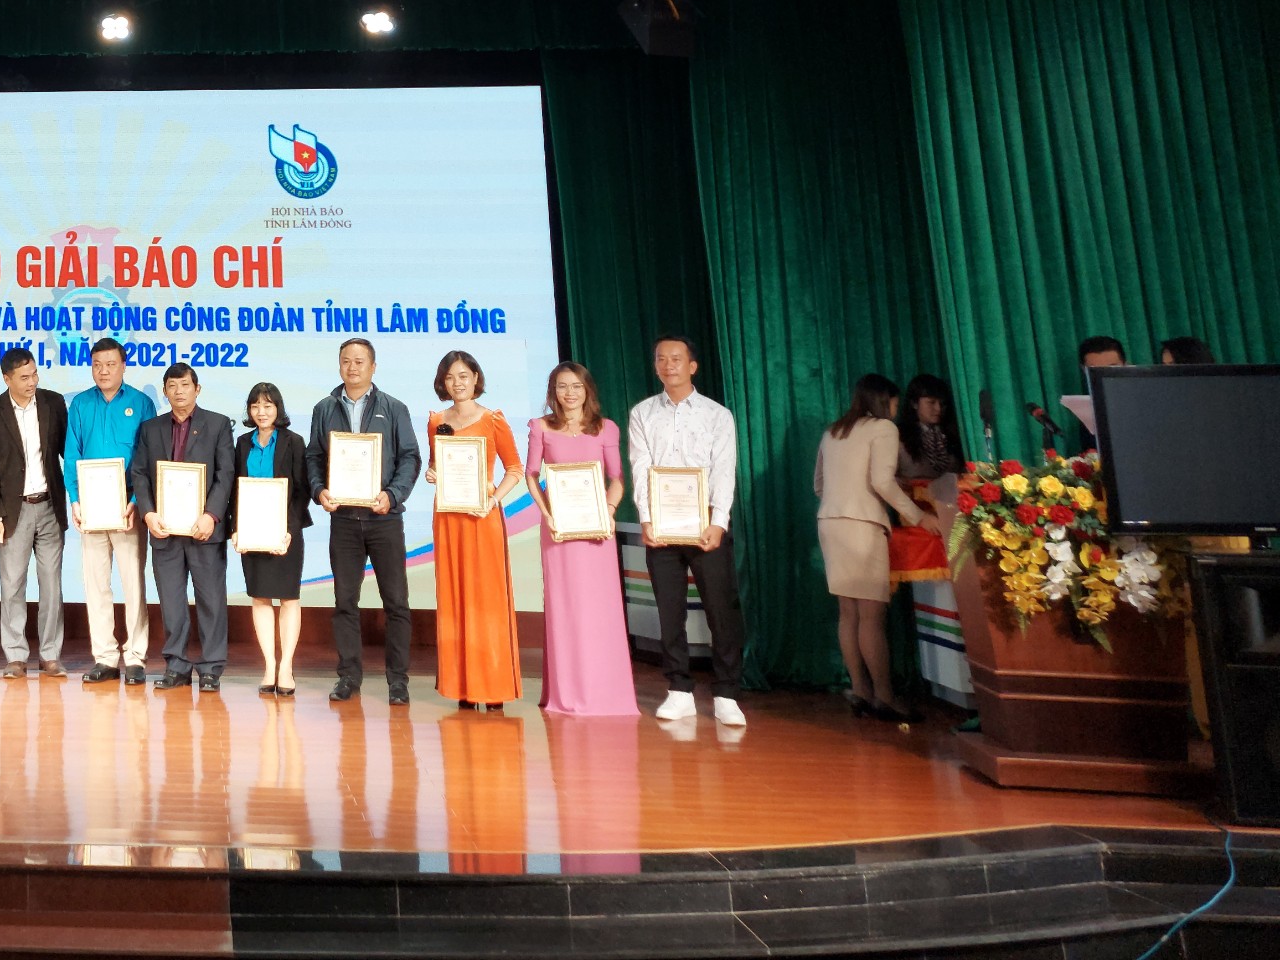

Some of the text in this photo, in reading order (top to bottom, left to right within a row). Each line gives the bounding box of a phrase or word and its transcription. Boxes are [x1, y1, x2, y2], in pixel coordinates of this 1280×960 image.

[320, 205, 344, 217] BÁO
[17, 230, 97, 288] GIẢI
[114, 236, 197, 288] BÁO
[213, 236, 283, 288] CHÍ
[25, 306, 85, 336] HOẠT
[91, 301, 157, 336] ĐỘNG
[165, 301, 231, 332] CÔNG
[237, 301, 305, 333] ĐOÀN
[311, 299, 368, 333] TỈNH
[376, 302, 429, 333] LÂM
[436, 299, 506, 334] ĐỒNG
[38, 341, 52, 369] I,
[59, 337, 99, 367] NĂ
[123, 342, 249, 367] 2021-2022
